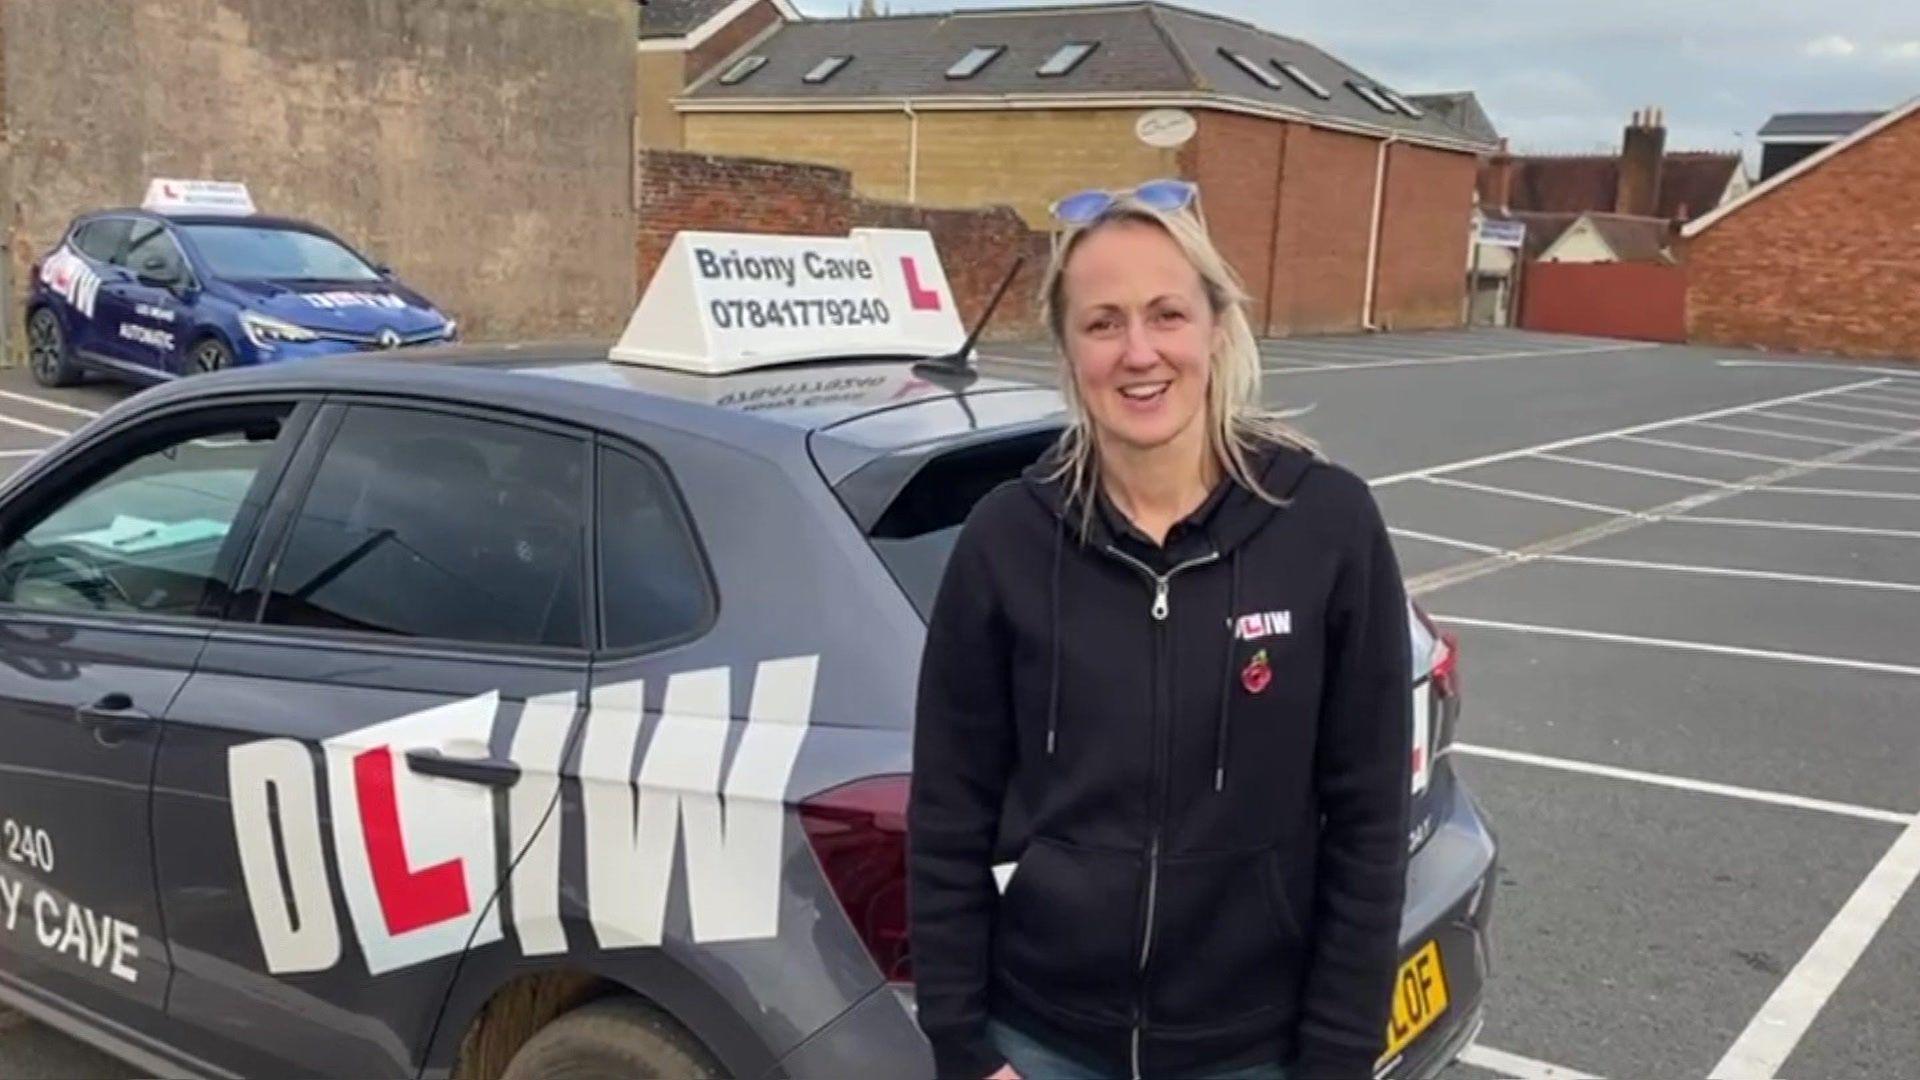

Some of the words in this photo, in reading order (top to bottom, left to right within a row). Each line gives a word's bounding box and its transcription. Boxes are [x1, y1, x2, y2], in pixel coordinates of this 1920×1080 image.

[696, 248, 796, 287] Briony
[804, 251, 873, 280] Cave
[900, 256, 941, 311] L
[711, 298, 891, 329] 07841779240
[5, 818, 54, 873] 240
[34, 889, 139, 983] CAVE
